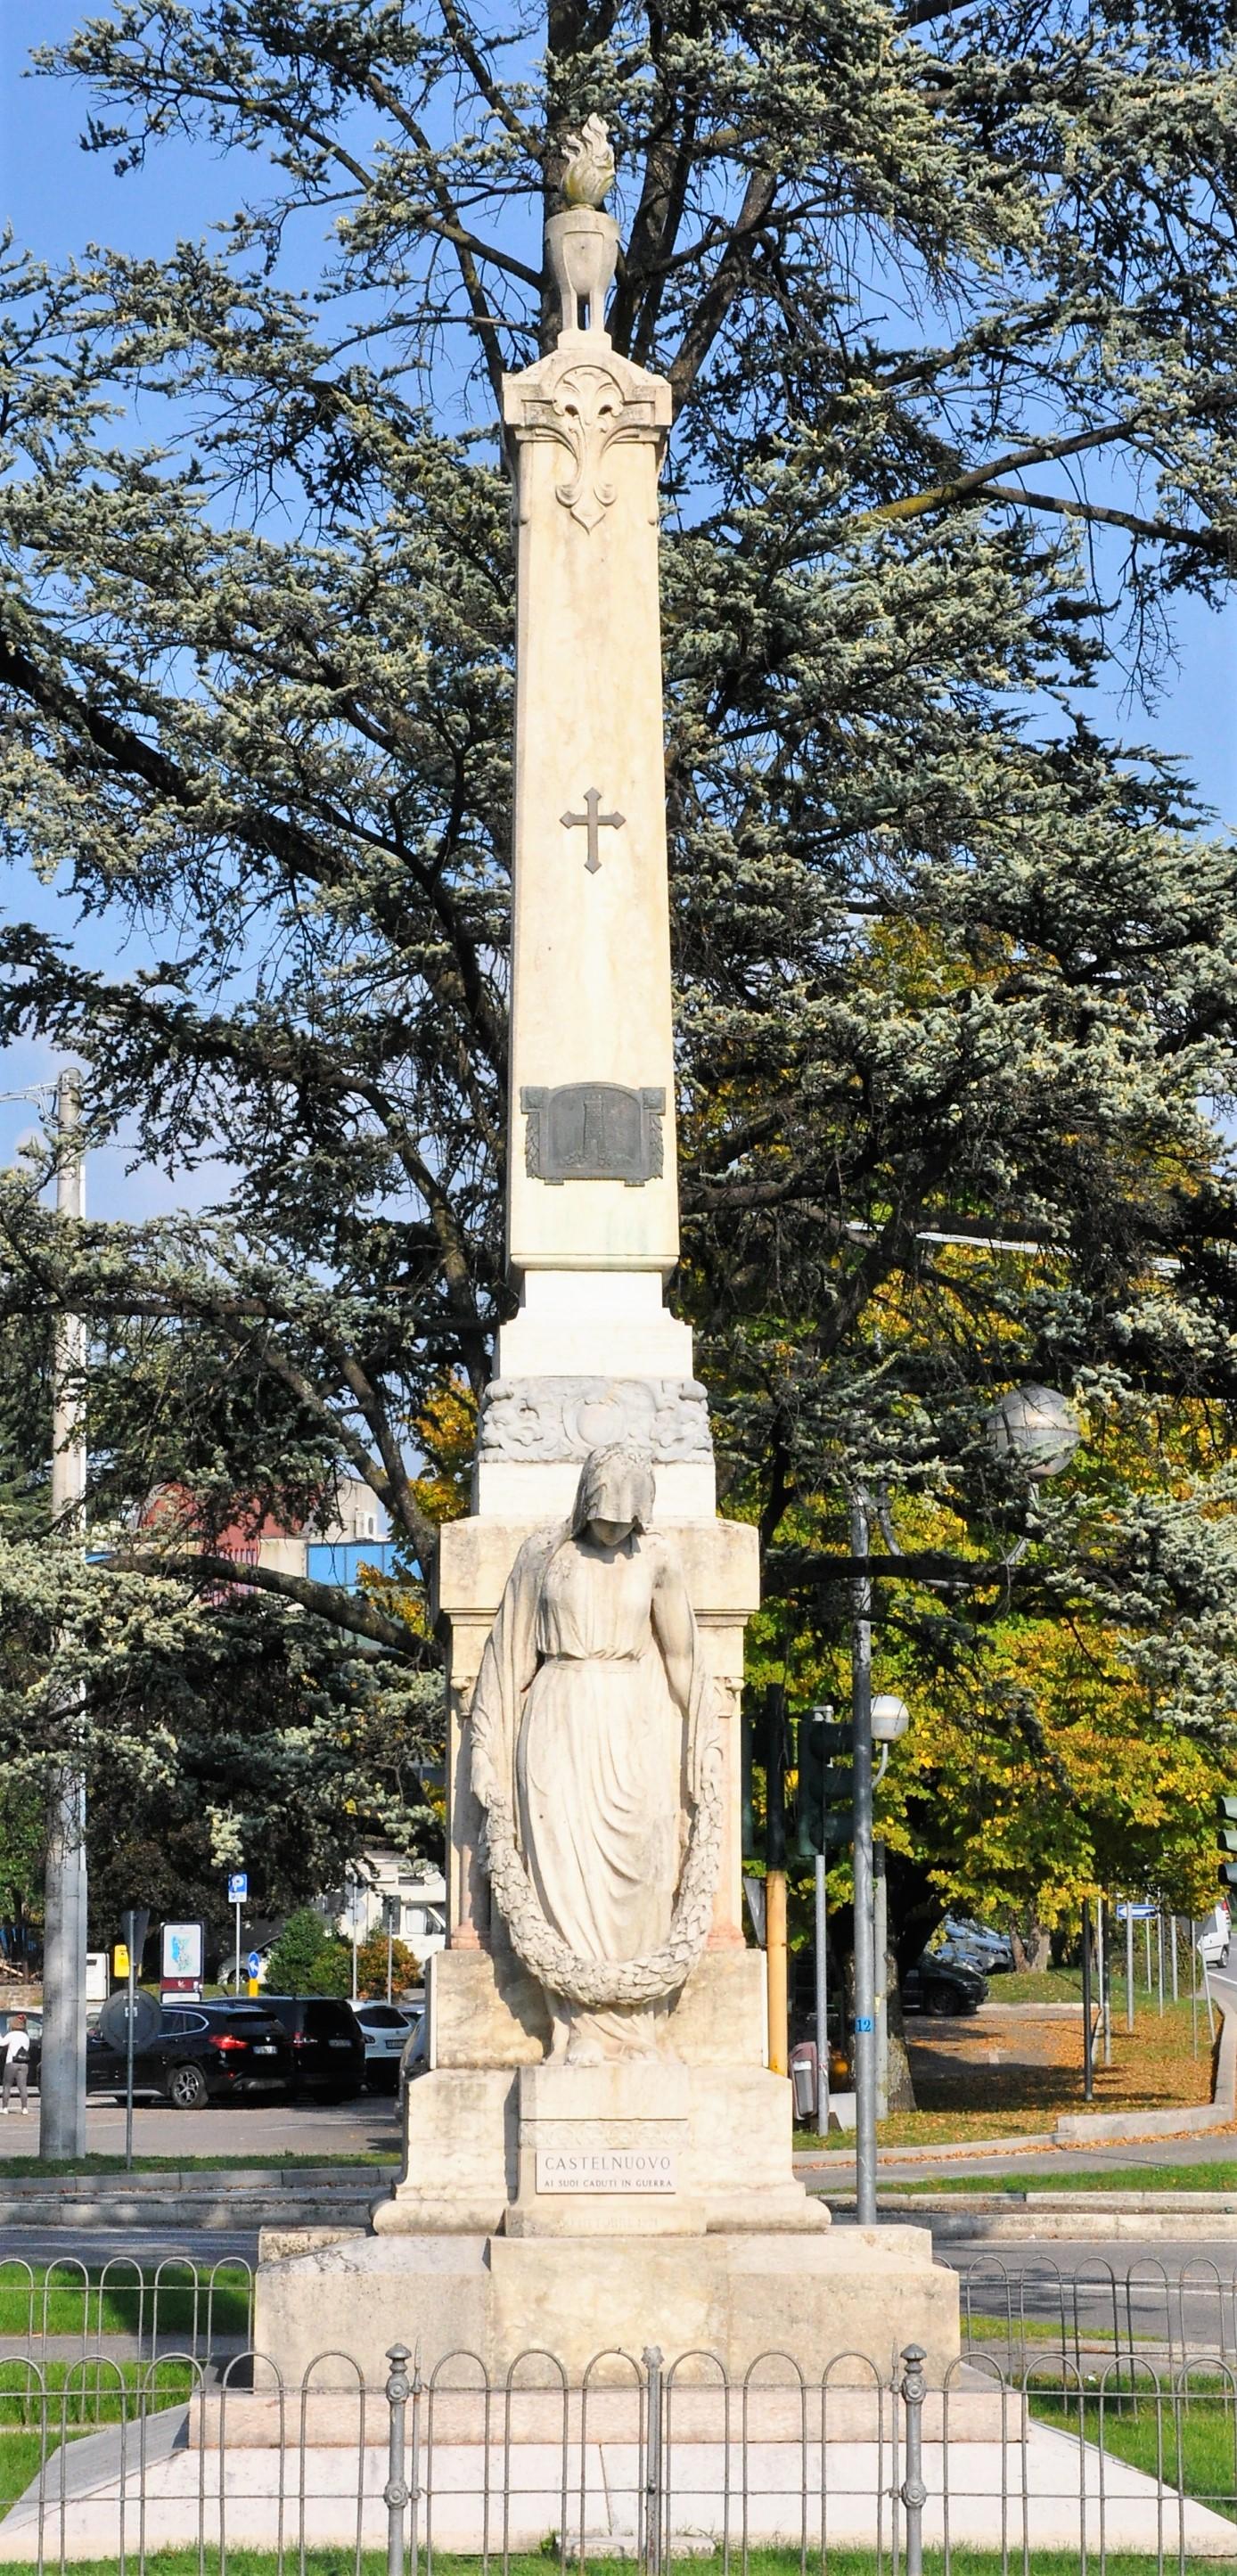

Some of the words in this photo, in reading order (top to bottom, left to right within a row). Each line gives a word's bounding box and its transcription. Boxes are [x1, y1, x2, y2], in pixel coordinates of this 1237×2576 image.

[856, 2019, 872, 2032] 12
[545, 2156, 671, 2170] CASTELNUOVO
[544, 2179, 554, 2187] AI
[558, 2179, 579, 2187] SUOI
[583, 2179, 617, 2187] CADUTI
[621, 2179, 632, 2187] IN
[635, 2179, 673, 2187] GUERRA
